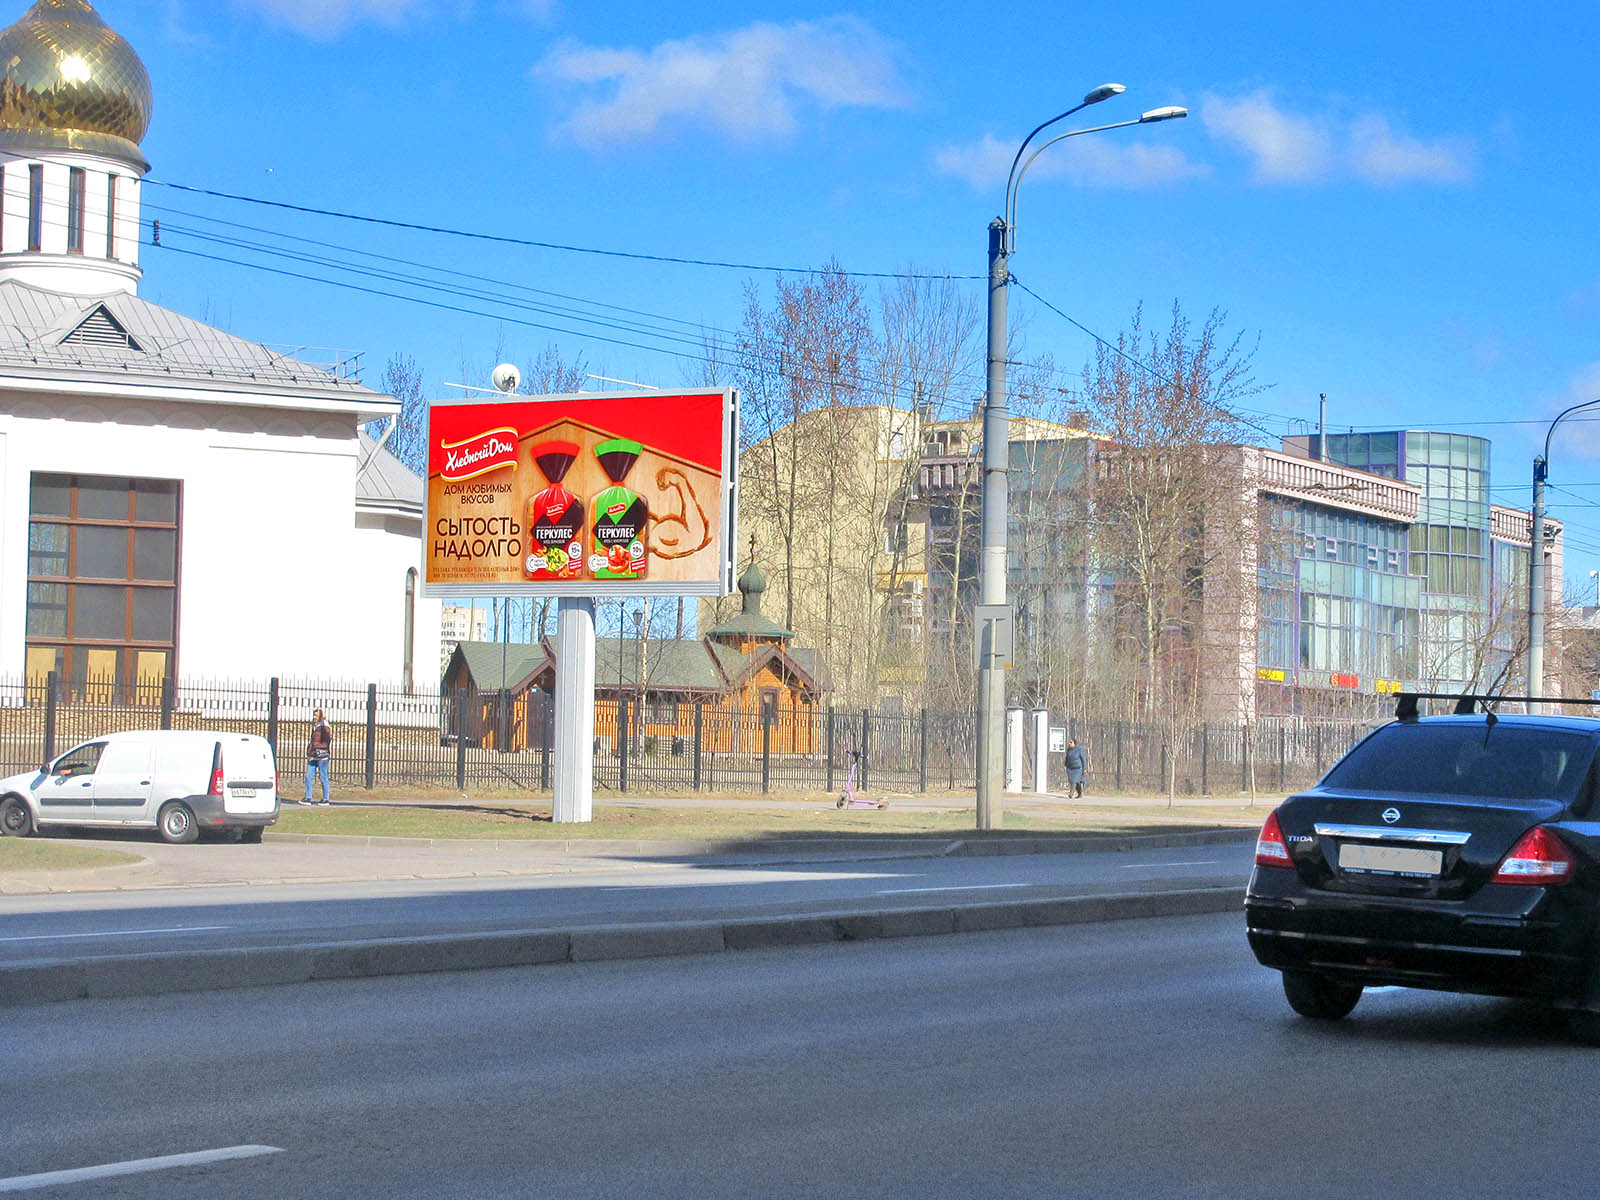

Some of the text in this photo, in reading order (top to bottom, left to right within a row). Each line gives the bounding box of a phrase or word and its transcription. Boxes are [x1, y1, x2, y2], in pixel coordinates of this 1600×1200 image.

[445, 438, 513, 471] Хлебный Дом
[444, 483, 512, 495] ДОМ ЛЮБИМЫХ
[461, 494, 494, 504] ВКУСОВ
[436, 517, 520, 536] СЫТОСТЬ
[598, 527, 635, 538] ГЕРКУЛЕС
[536, 528, 573, 539] ГЕРКУЛЕС
[434, 539, 521, 560] НАДОЛГО
